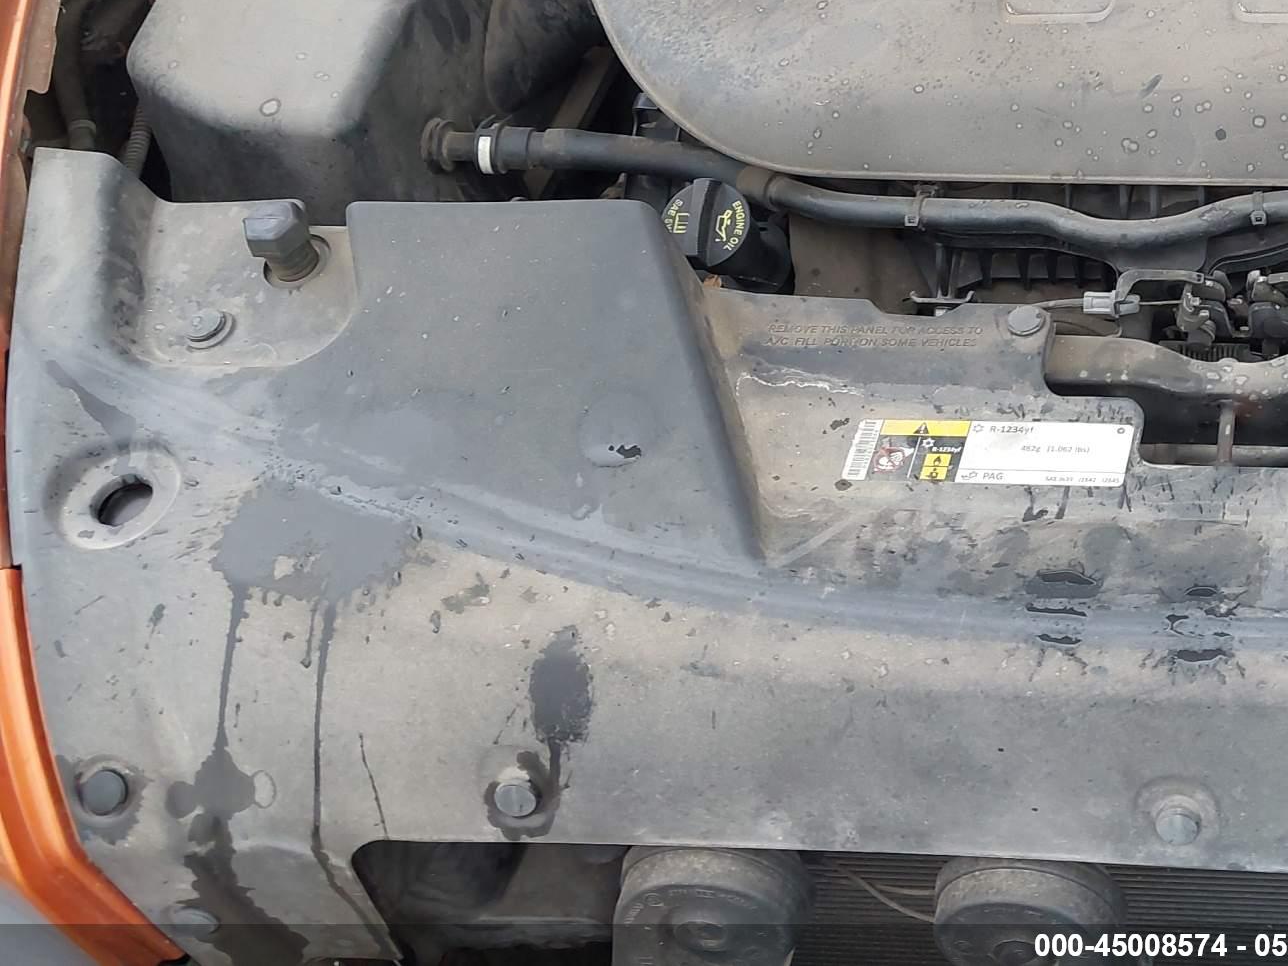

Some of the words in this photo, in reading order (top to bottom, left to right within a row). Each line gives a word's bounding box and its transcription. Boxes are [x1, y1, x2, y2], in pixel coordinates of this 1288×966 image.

[732, 200, 745, 236] ENGINE
[723, 237, 739, 251] OIL
[767, 324, 817, 334] REMOVE
[820, 325, 847, 334] THIS
[850, 325, 888, 335] PANEL
[918, 325, 964, 335] ACCESS
[967, 326, 984, 335] TO
[766, 337, 788, 347] A/C
[793, 337, 818, 346] FILL
[880, 337, 918, 347] SOME
[921, 338, 978, 347] VEHICLES
[989, 425, 1034, 435] R-1234yf
[982, 472, 1004, 481] PAG
